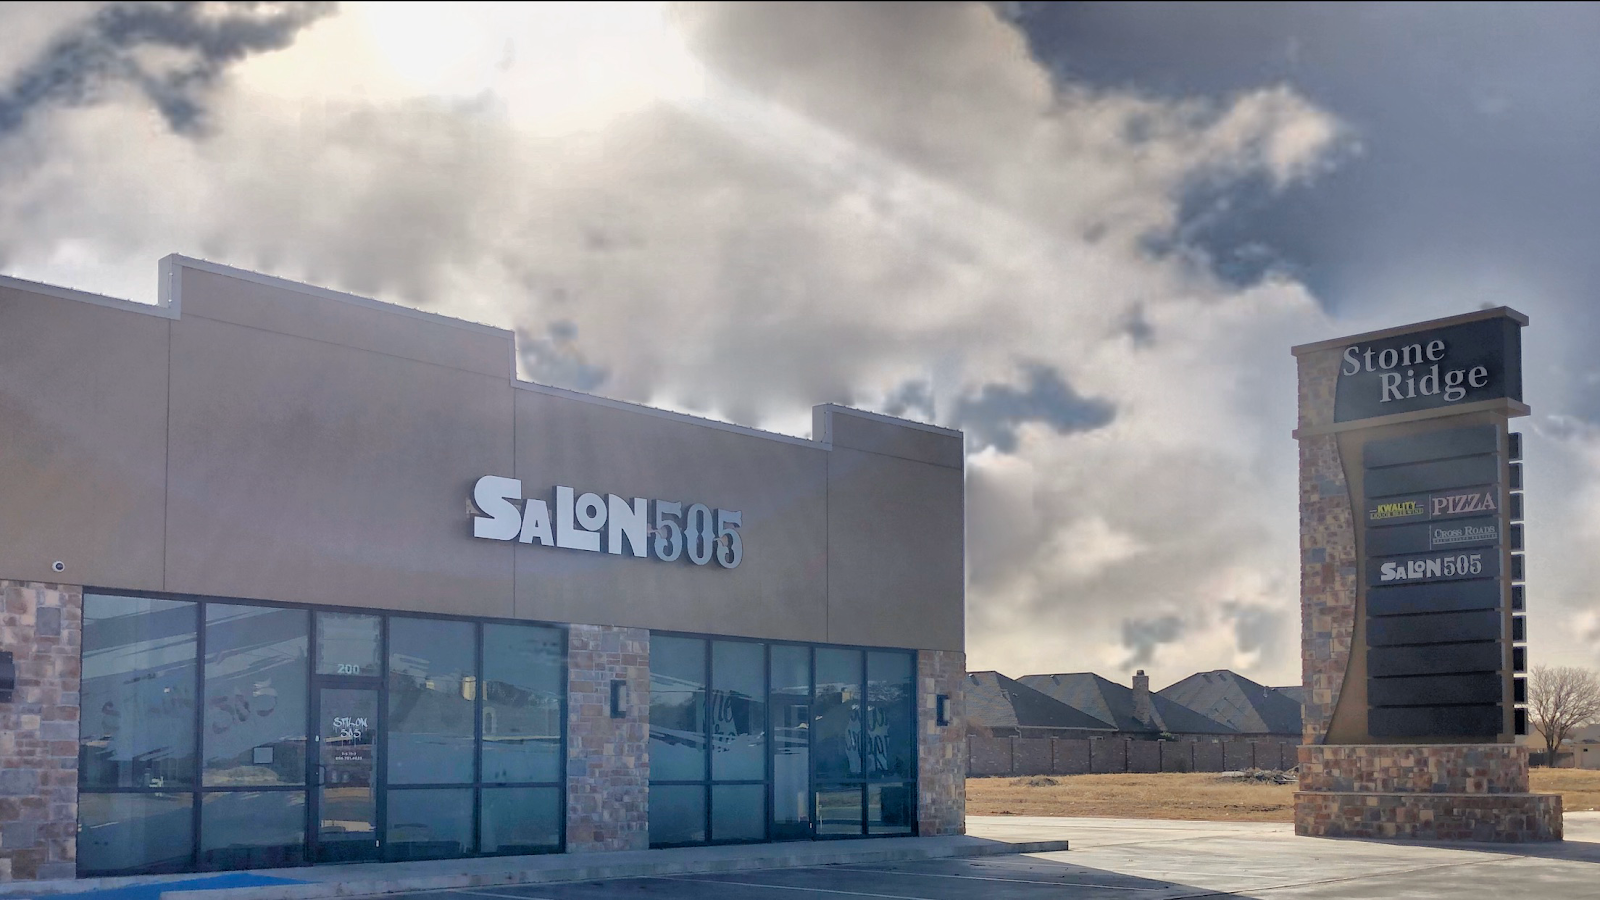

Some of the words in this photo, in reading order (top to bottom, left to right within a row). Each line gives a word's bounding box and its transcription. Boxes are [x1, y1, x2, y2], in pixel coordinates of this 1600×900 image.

[1343, 340, 1445, 376] Stone
[1379, 364, 1488, 402] Ridge
[1377, 501, 1417, 514] KWALITY
[1432, 492, 1497, 515] PIZZA
[473, 475, 648, 558] SALON
[652, 499, 743, 569] 505
[1380, 558, 1442, 581] SALON
[1443, 554, 1482, 576] 505
[337, 664, 360, 675] 200
